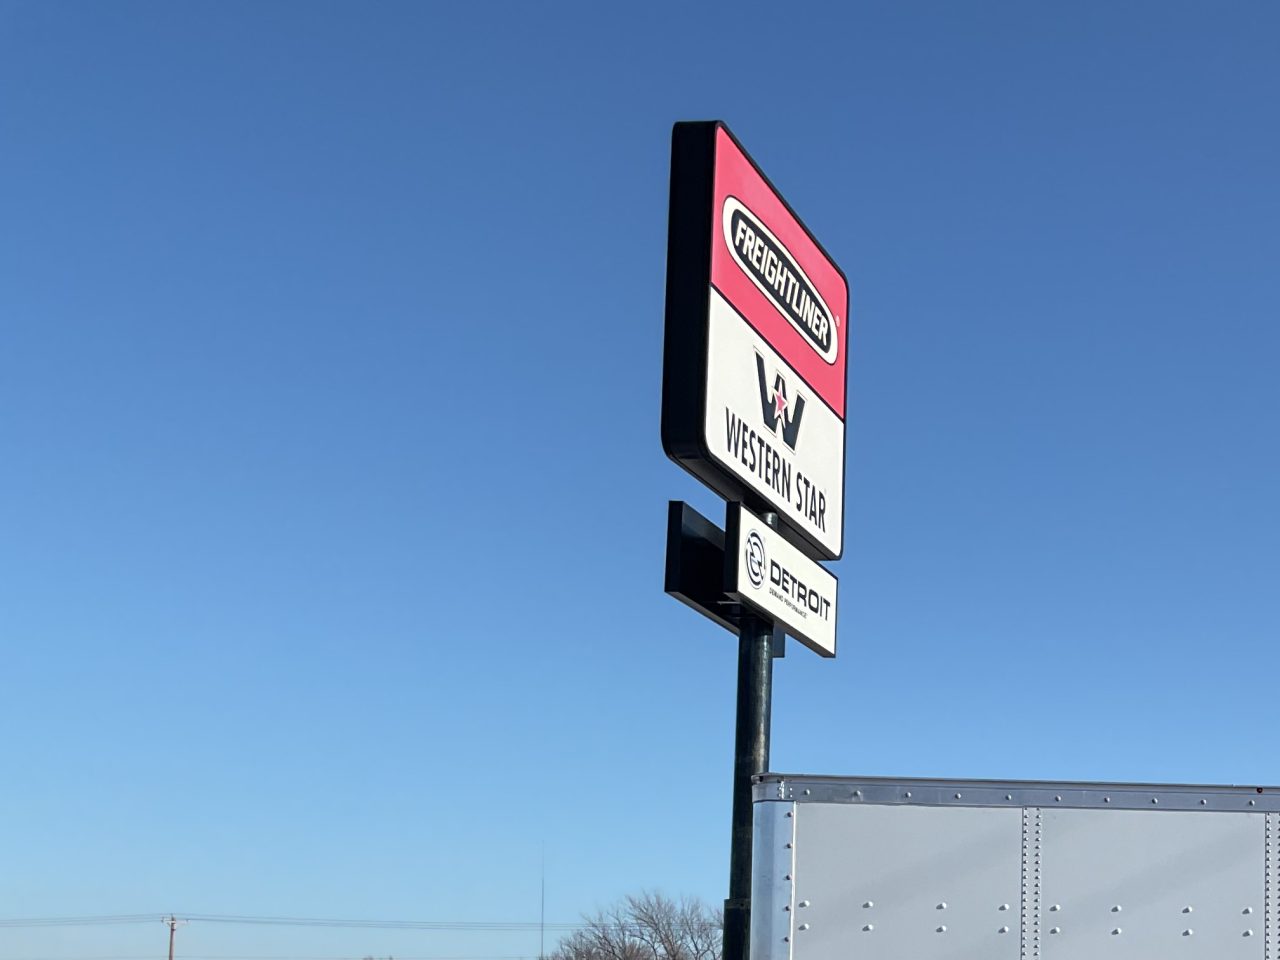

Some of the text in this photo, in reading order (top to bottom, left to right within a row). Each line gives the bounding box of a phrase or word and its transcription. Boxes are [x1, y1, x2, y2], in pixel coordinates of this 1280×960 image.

[735, 218, 829, 346] FREIGHTLINER
[725, 406, 827, 533] WESTERN STAR
[770, 558, 831, 621] DETROIT
